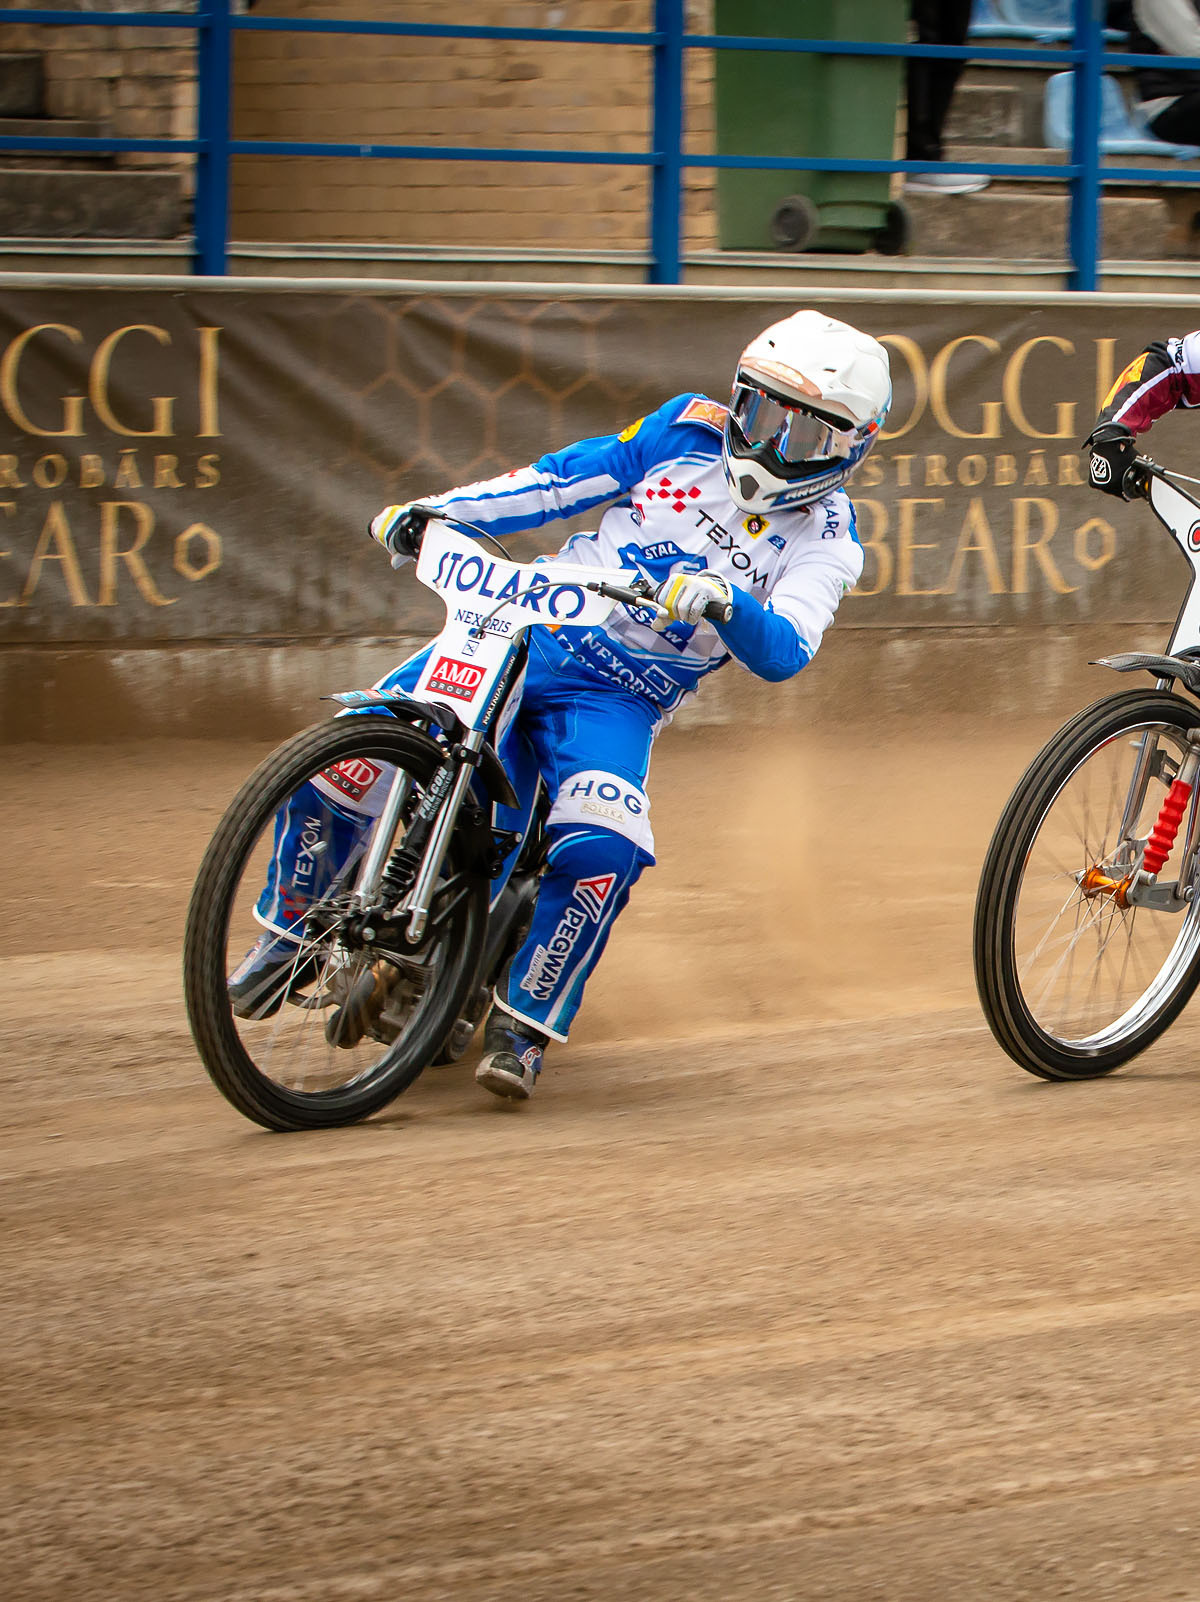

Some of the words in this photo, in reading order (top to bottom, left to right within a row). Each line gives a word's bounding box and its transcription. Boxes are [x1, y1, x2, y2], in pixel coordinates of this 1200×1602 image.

[872, 334, 1120, 440] OGGI
[644, 542, 678, 560] STAL
[695, 508, 769, 589] TEXOM
[845, 497, 1082, 596] BEAR
[432, 551, 586, 620] STOLARO
[454, 608, 512, 634] NEXORIS
[430, 680, 472, 699] GROUP
[432, 661, 482, 688] AMD
[334, 759, 375, 786] MD
[418, 765, 448, 819] FALCON
[570, 780, 643, 815] HOG
[582, 802, 624, 821] POLSKA
[291, 814, 322, 888] TEXOM
[531, 907, 587, 999] PEGWAN
